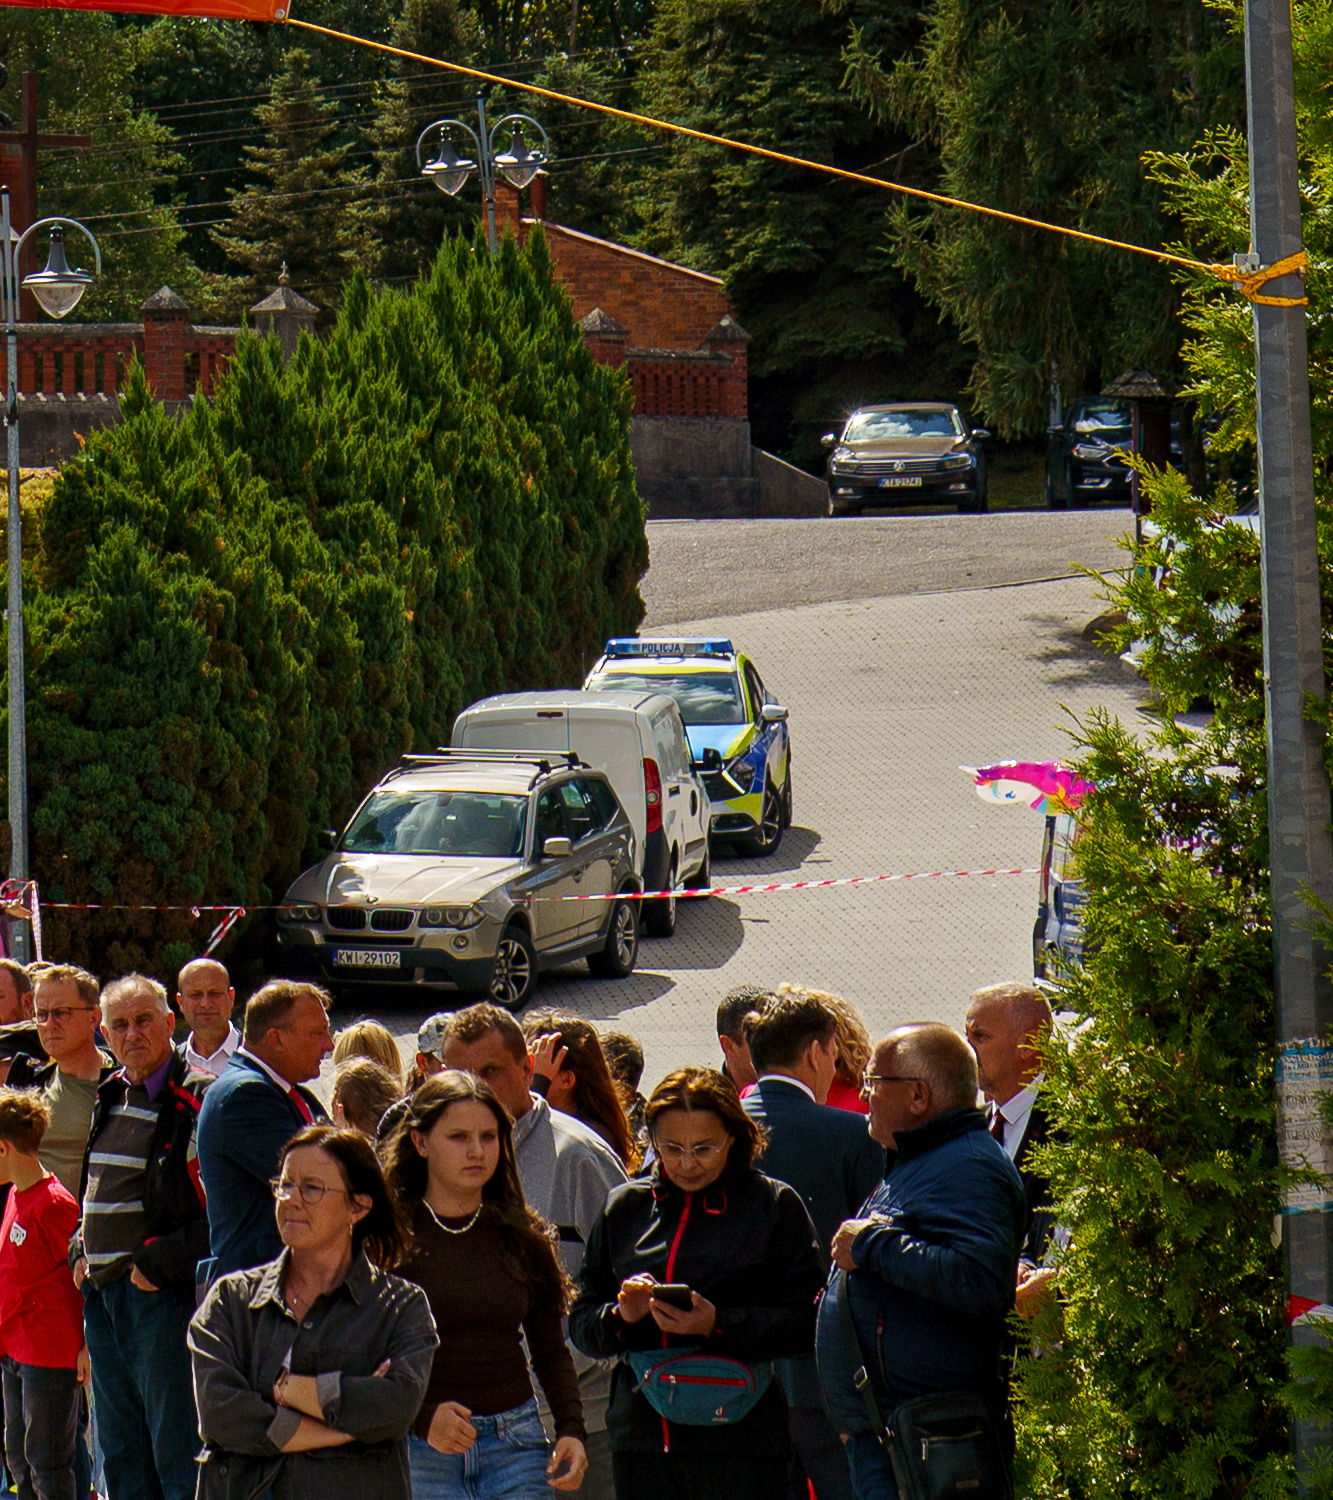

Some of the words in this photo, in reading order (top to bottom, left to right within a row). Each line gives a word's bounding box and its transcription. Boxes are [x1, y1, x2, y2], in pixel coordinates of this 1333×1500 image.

[641, 643, 681, 653] POLICJA
[339, 951, 359, 964] KWI
[364, 951, 399, 966] 29102
